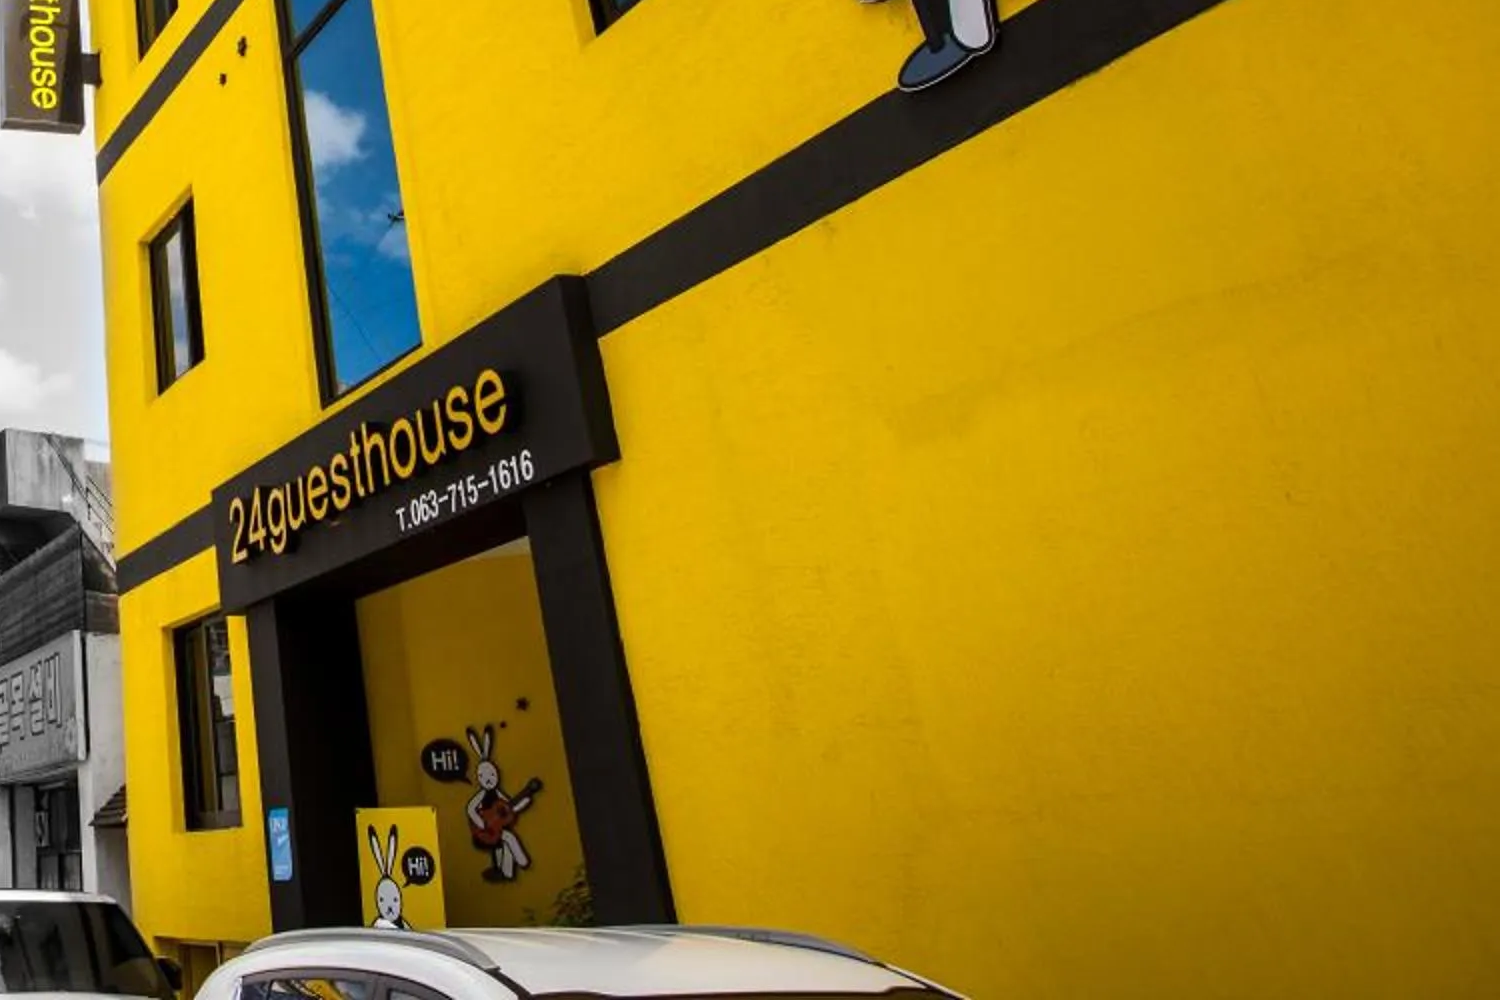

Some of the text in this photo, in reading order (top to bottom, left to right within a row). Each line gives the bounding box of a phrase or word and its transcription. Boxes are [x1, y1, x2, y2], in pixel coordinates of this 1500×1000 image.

[229, 369, 506, 564] 24guesthouse
[431, 749, 460, 772] Hi!
[407, 856, 430, 878] Hi!
